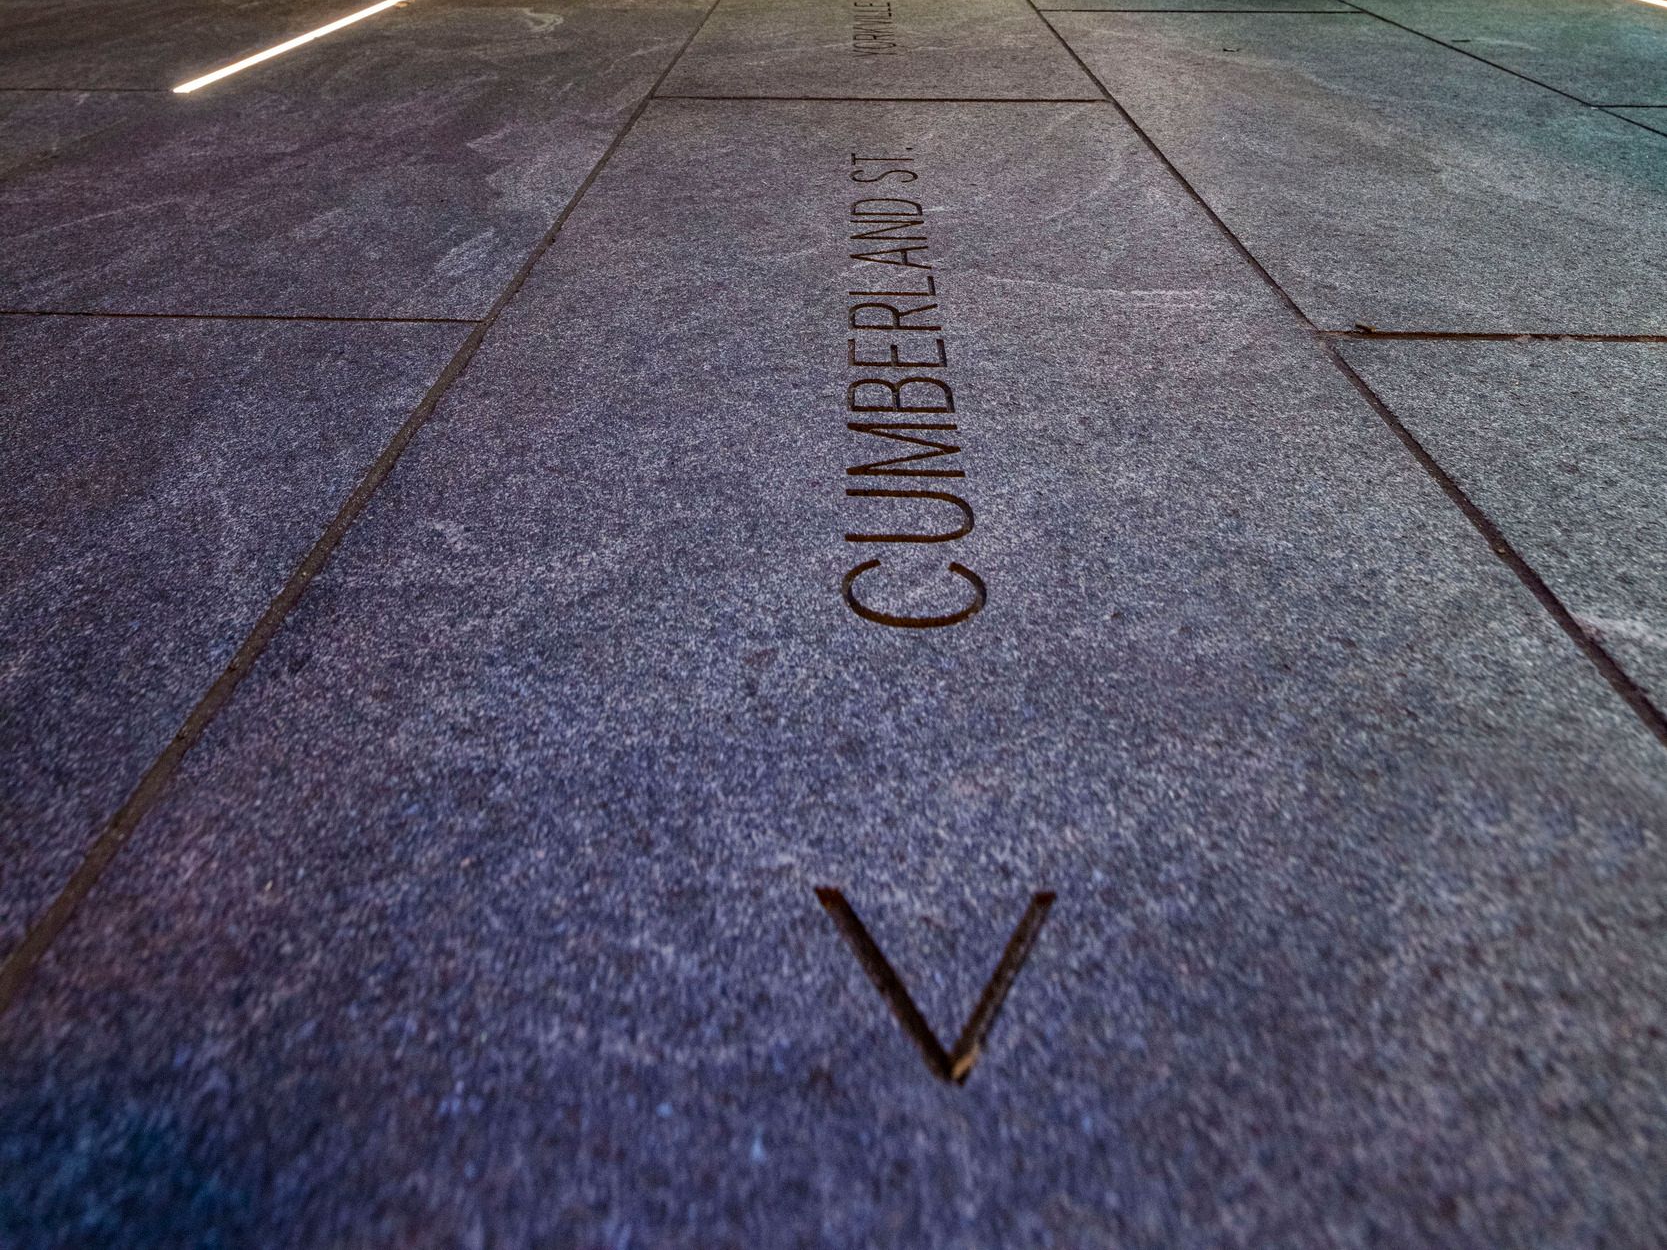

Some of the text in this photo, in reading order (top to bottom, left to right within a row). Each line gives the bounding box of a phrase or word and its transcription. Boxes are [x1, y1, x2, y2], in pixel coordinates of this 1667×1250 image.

[852, 1, 898, 58] YORKVILLE
[842, 146, 987, 629] CUMBERLAND ST.
